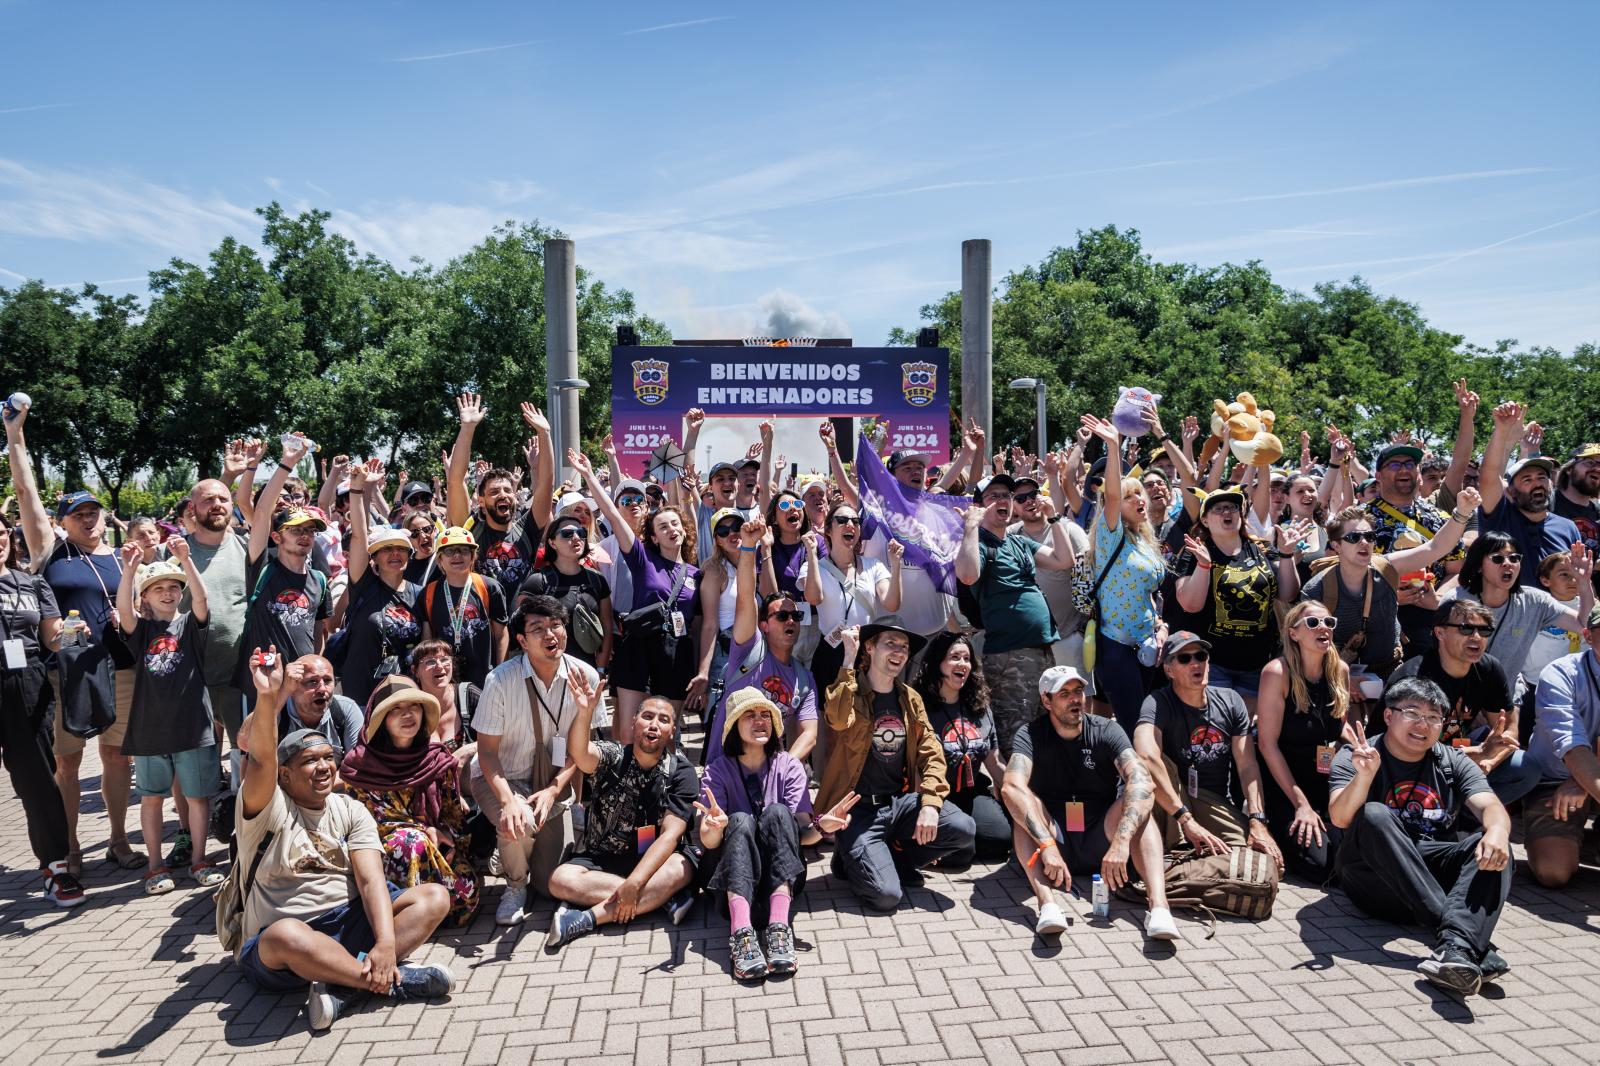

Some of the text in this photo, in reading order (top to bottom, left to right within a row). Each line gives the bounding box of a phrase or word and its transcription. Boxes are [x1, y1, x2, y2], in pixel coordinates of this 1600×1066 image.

[710, 363, 861, 381] BIENVENIDOS
[639, 386, 663, 394] FEST
[697, 387, 874, 405] ENTRENADORES
[907, 388, 931, 396] FEST
[892, 433, 938, 447] 2024
